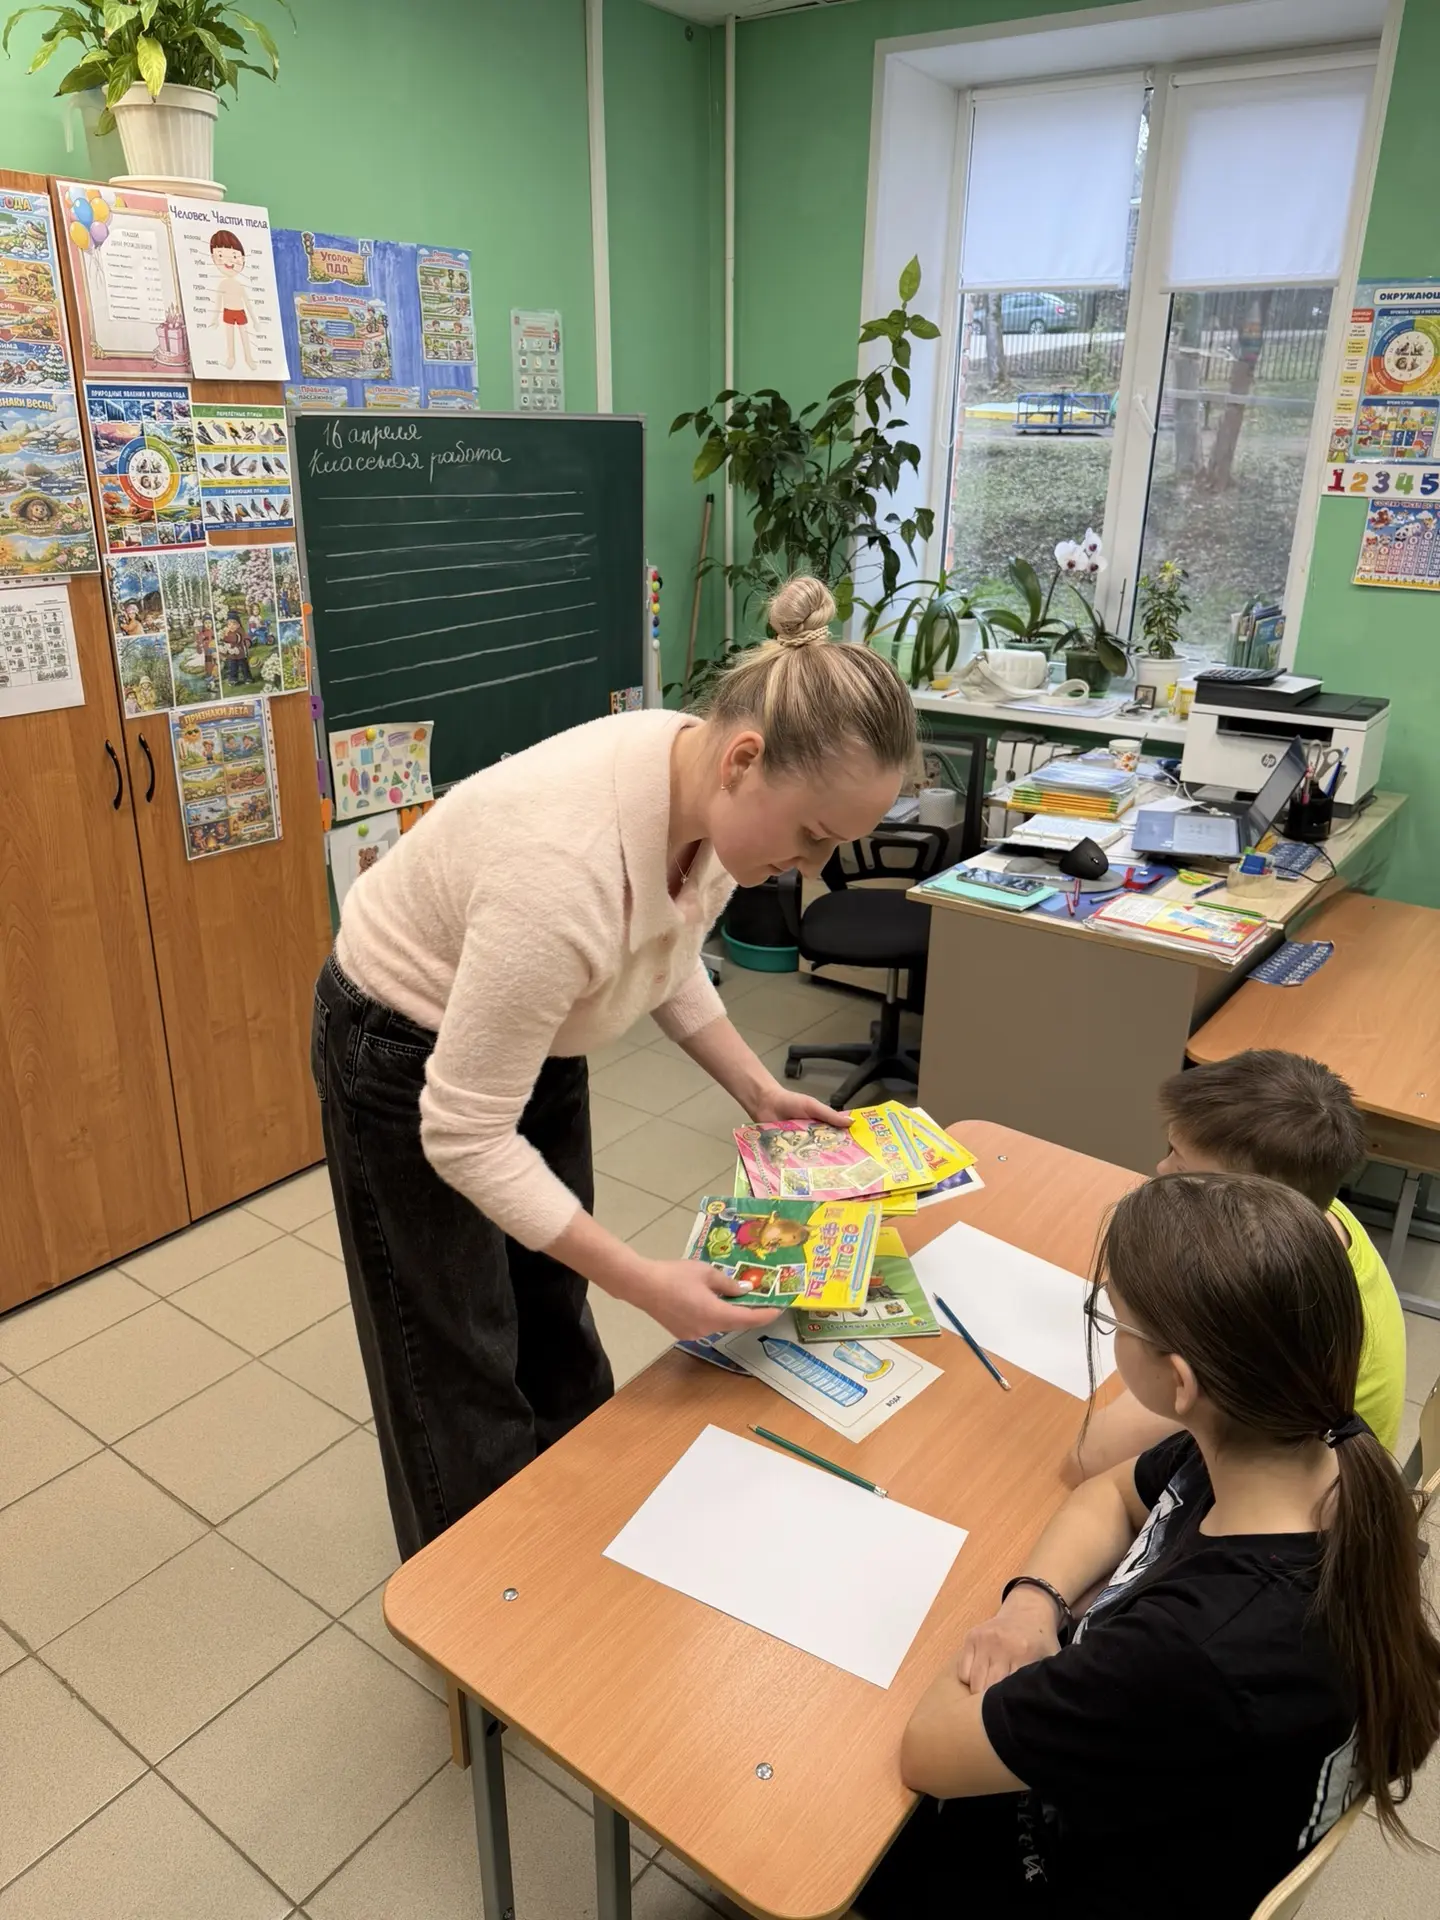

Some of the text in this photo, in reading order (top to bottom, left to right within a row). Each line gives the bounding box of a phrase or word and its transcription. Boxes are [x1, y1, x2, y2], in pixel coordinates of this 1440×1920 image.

[211, 210, 244, 226] Части
[244, 218, 269, 229] тела
[320, 251, 353, 264] Уголок
[326, 263, 350, 276] ПДД
[91, 390, 122, 398] ПРИРОДНЫЕ
[172, 391, 186, 399] ГОДА
[323, 420, 423, 450] 16 апреля
[429, 440, 512, 484] работа
[1328, 468, 1440, 495] 1 2 3 4 5
[184, 706, 249, 724] ПРИЗНАКИ ЛЕТА
[861, 1109, 909, 1183] НАСЕКОМЫЕ
[805, 1221, 839, 1298] ФРУКТЫ
[830, 1223, 859, 1281] ОВОЩИ
[886, 1395, 901, 1407] ВОДА
